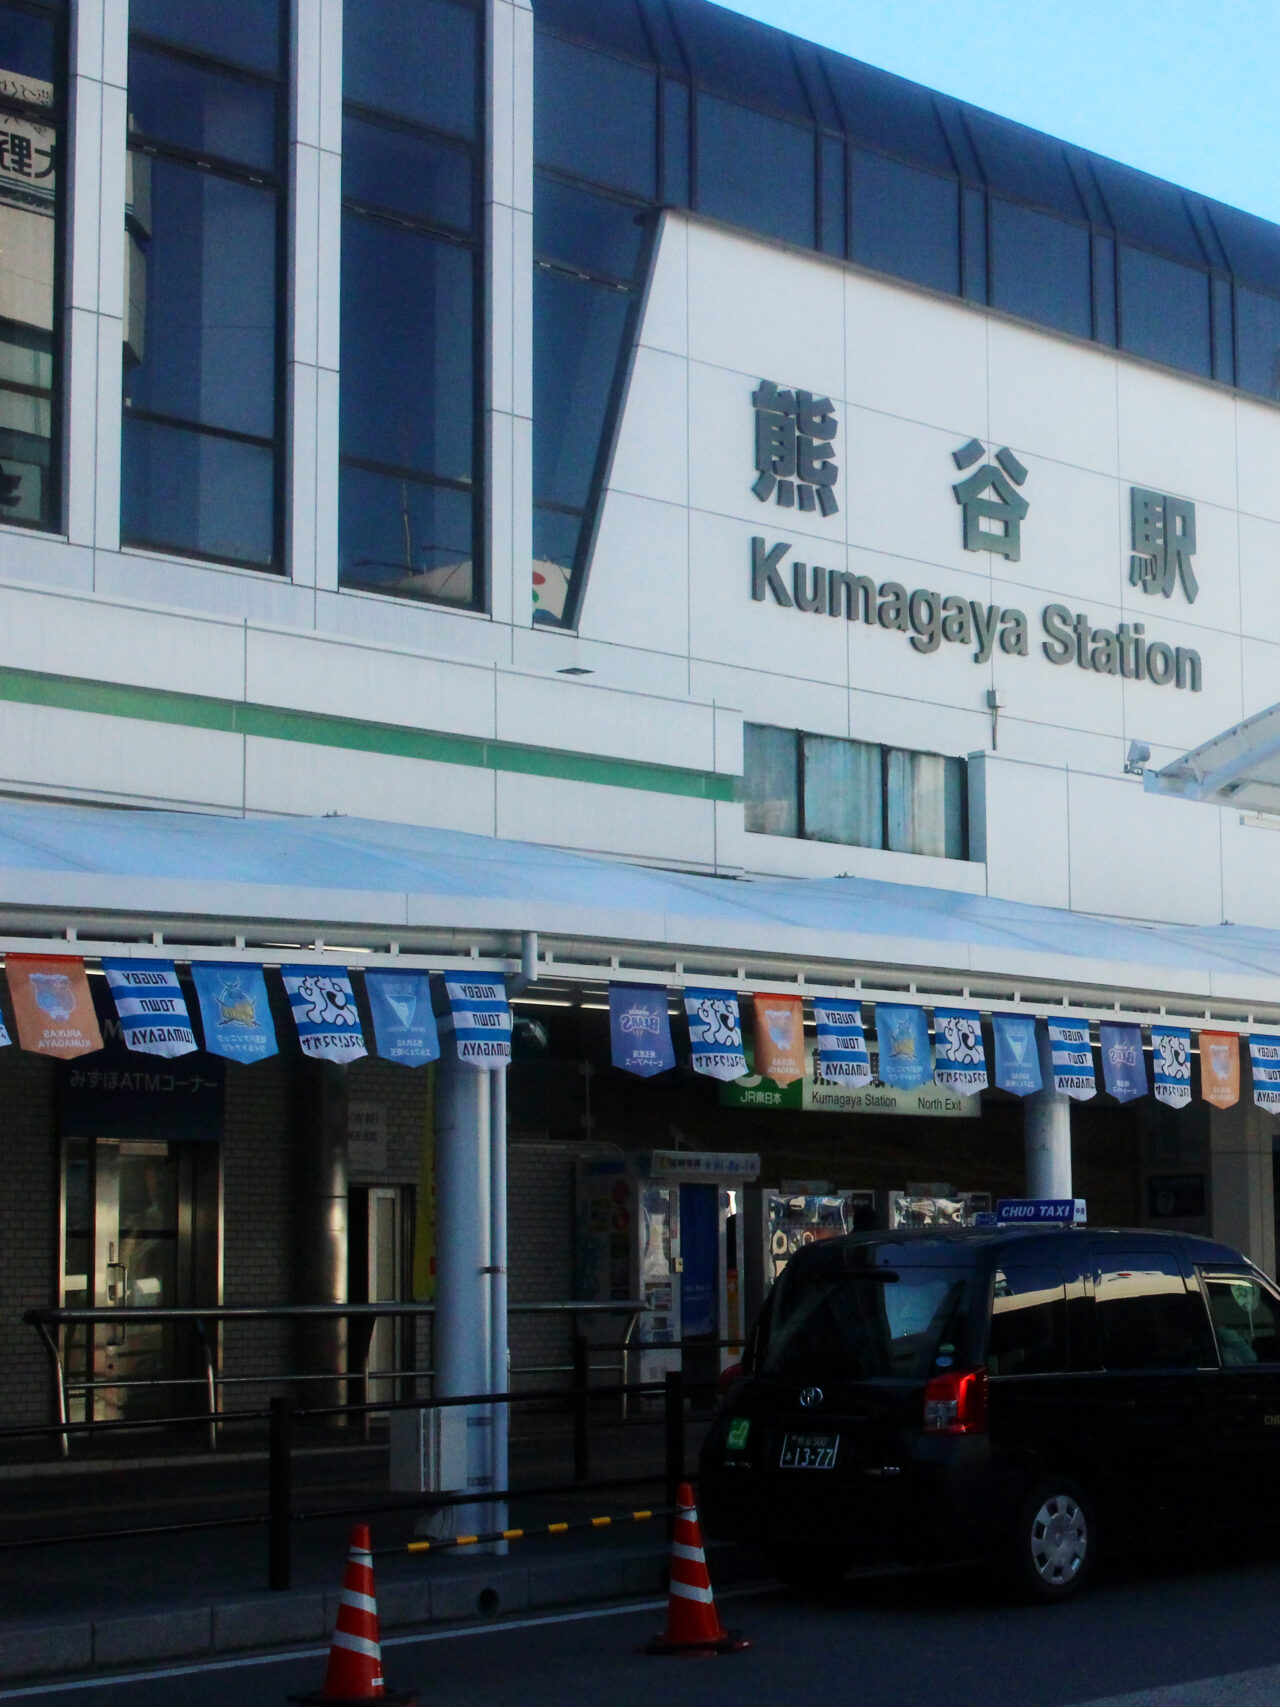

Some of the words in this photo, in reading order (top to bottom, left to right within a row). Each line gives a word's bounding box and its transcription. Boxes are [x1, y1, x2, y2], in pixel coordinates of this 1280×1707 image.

[751, 379, 1199, 605] 熊谷駅
[751, 536, 1029, 665] Kumagaya
[1042, 603, 1202, 693] Station
[739, 1090, 782, 1105] JR東日本
[811, 1091, 862, 1109] Kumagaya
[864, 1093, 897, 1108] Station
[918, 1097, 943, 1110] North
[945, 1098, 962, 1111] Exit
[1001, 1206, 1035, 1217] CHUO
[1039, 1205, 1070, 1217] TAXI
[794, 1447, 834, 1467] 13-77
